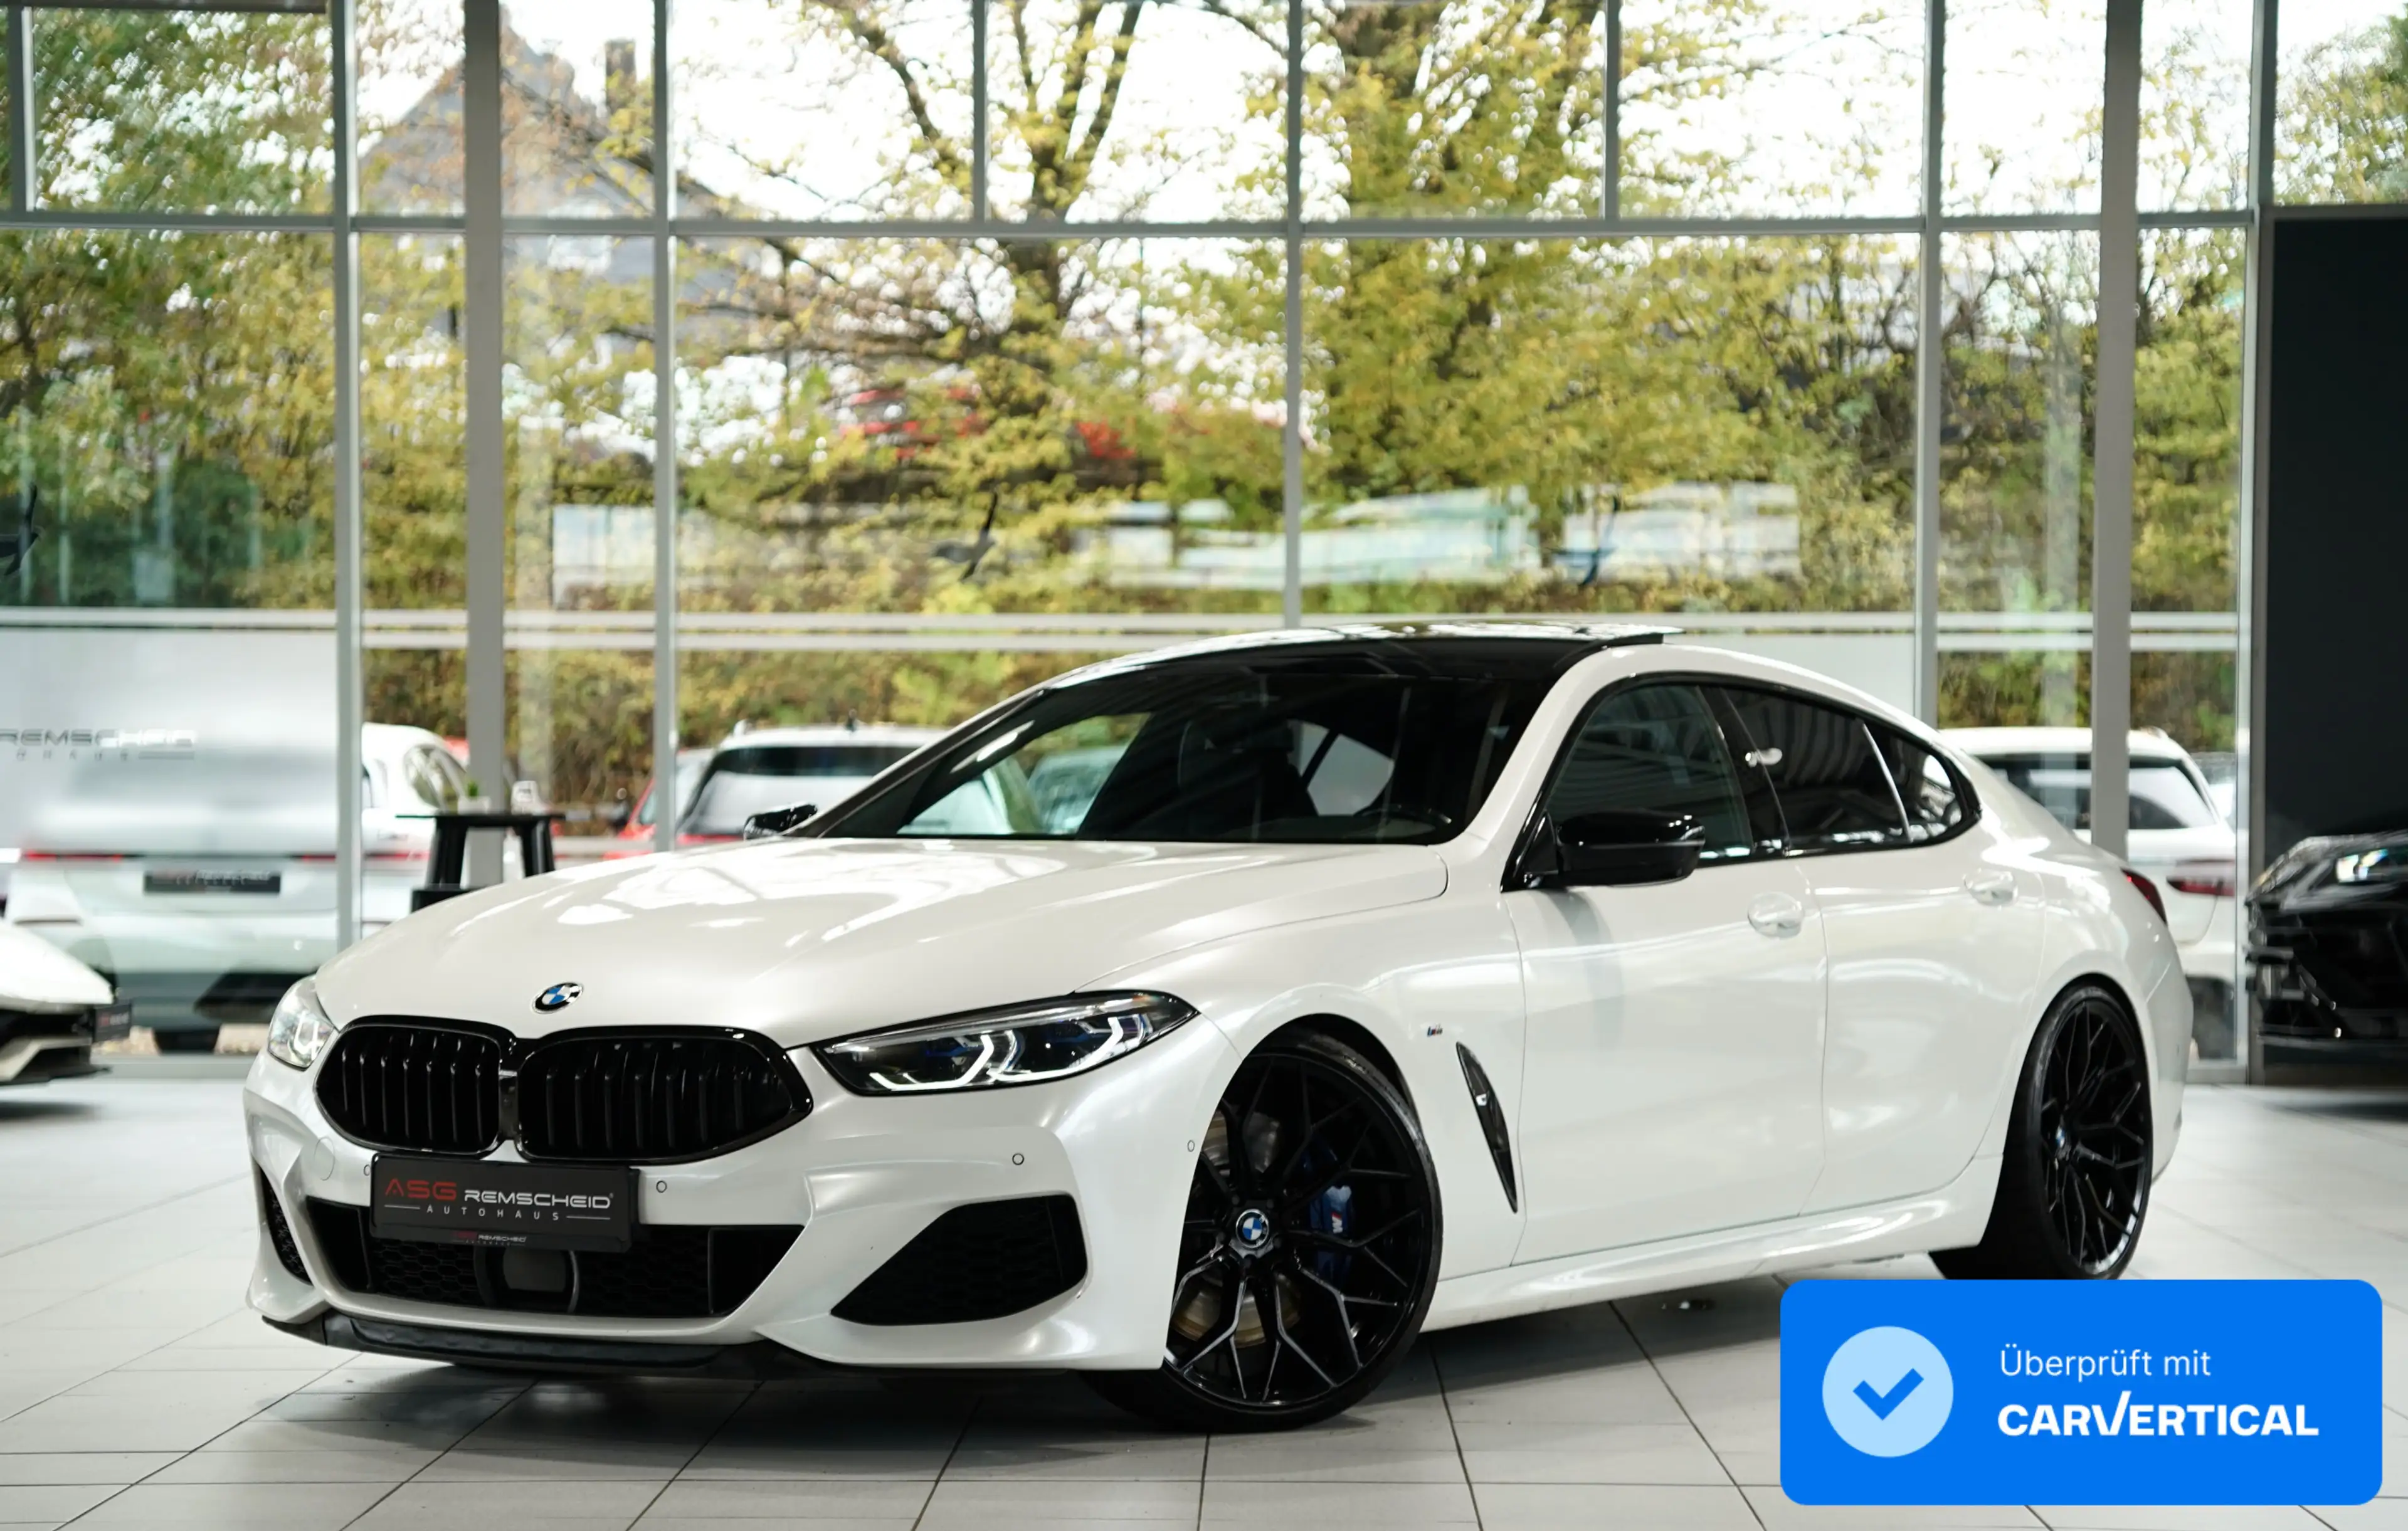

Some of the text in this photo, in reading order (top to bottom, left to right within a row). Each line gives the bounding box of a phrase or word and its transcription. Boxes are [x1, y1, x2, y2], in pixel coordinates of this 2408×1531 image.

[384, 1178, 611, 1209] ASG REMSCHEID
[426, 1204, 560, 1221] AUTOHAUS
